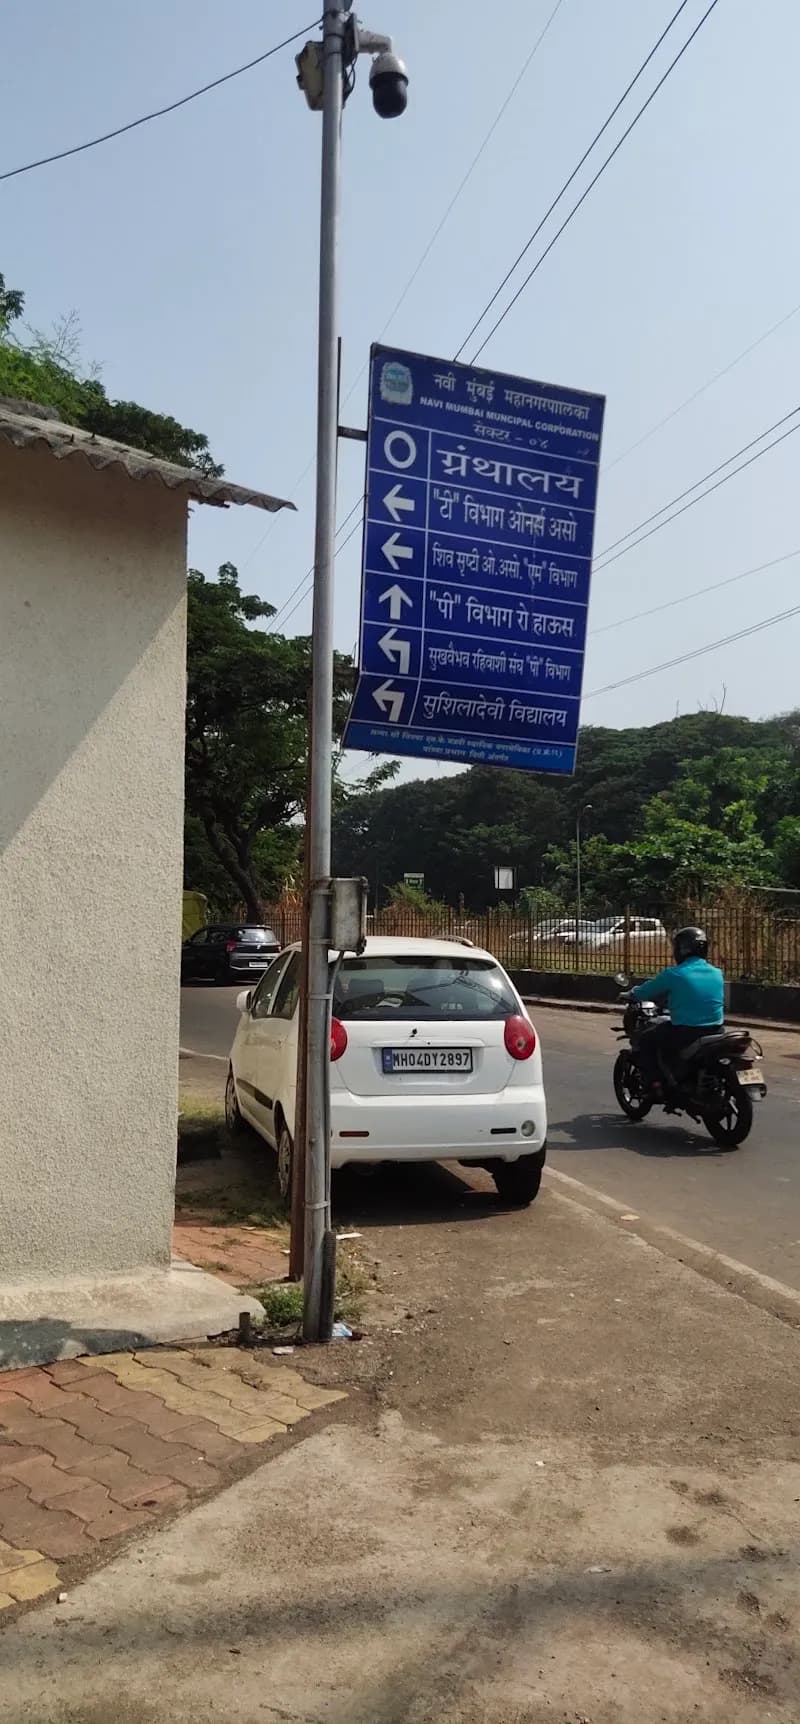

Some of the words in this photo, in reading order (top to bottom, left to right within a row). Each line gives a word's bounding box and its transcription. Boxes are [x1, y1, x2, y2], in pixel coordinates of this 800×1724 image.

[434, 372, 456, 392] नवी
[466, 378, 495, 403] मुंबई
[420, 397, 443, 409] NAVI
[445, 402, 484, 418] MUMBAI
[486, 409, 533, 428] MUNCIPAL
[535, 421, 600, 441] CORPORATION
[436, 444, 584, 499] ग्रंथालय
[433, 488, 459, 520] "टी"
[463, 495, 504, 529] विभाग
[549, 512, 577, 542] असो
[432, 542, 454, 568] शिव
[456, 548, 479, 576] सृष्टी
[548, 562, 578, 588] विभाग
[430, 590, 461, 620] "पी"
[465, 596, 513, 629] विभाग
[516, 603, 529, 630] रो
[428, 642, 470, 671] सुखवैभव
[472, 648, 507, 673] रहिवाशी
[508, 652, 524, 676] संघ
[545, 659, 572, 681] विभाग
[423, 691, 505, 721] सुशिलादेवी
[508, 699, 568, 728] विद्यालय
[393, 1053, 470, 1067] MH04DY2897
